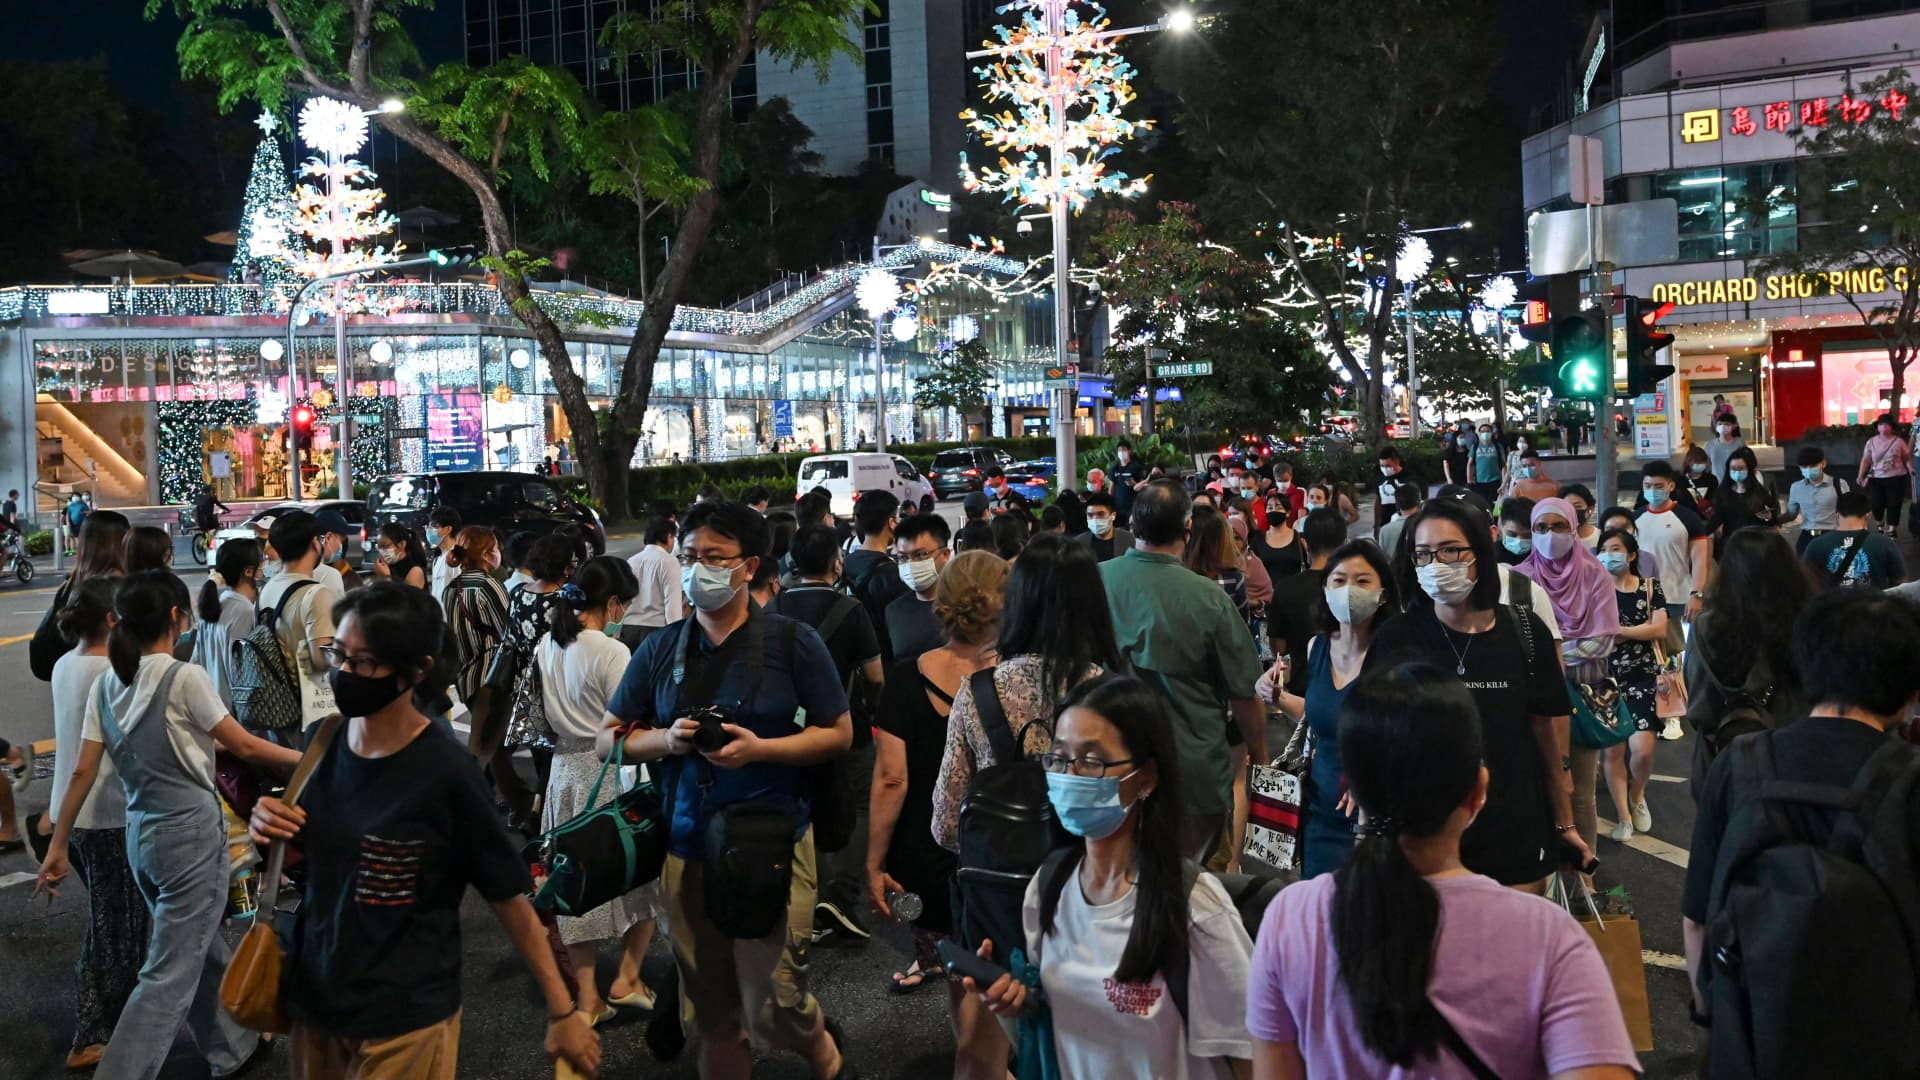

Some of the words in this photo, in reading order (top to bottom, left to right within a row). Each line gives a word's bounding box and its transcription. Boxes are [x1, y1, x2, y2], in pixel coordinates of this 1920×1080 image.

[1653, 278, 1758, 306] ORCHARD
[1158, 364, 1193, 376] GRANGE
[1195, 363, 1208, 374] RD
[1249, 838, 1266, 857] LOVE
[1266, 849, 1280, 865] YOU
